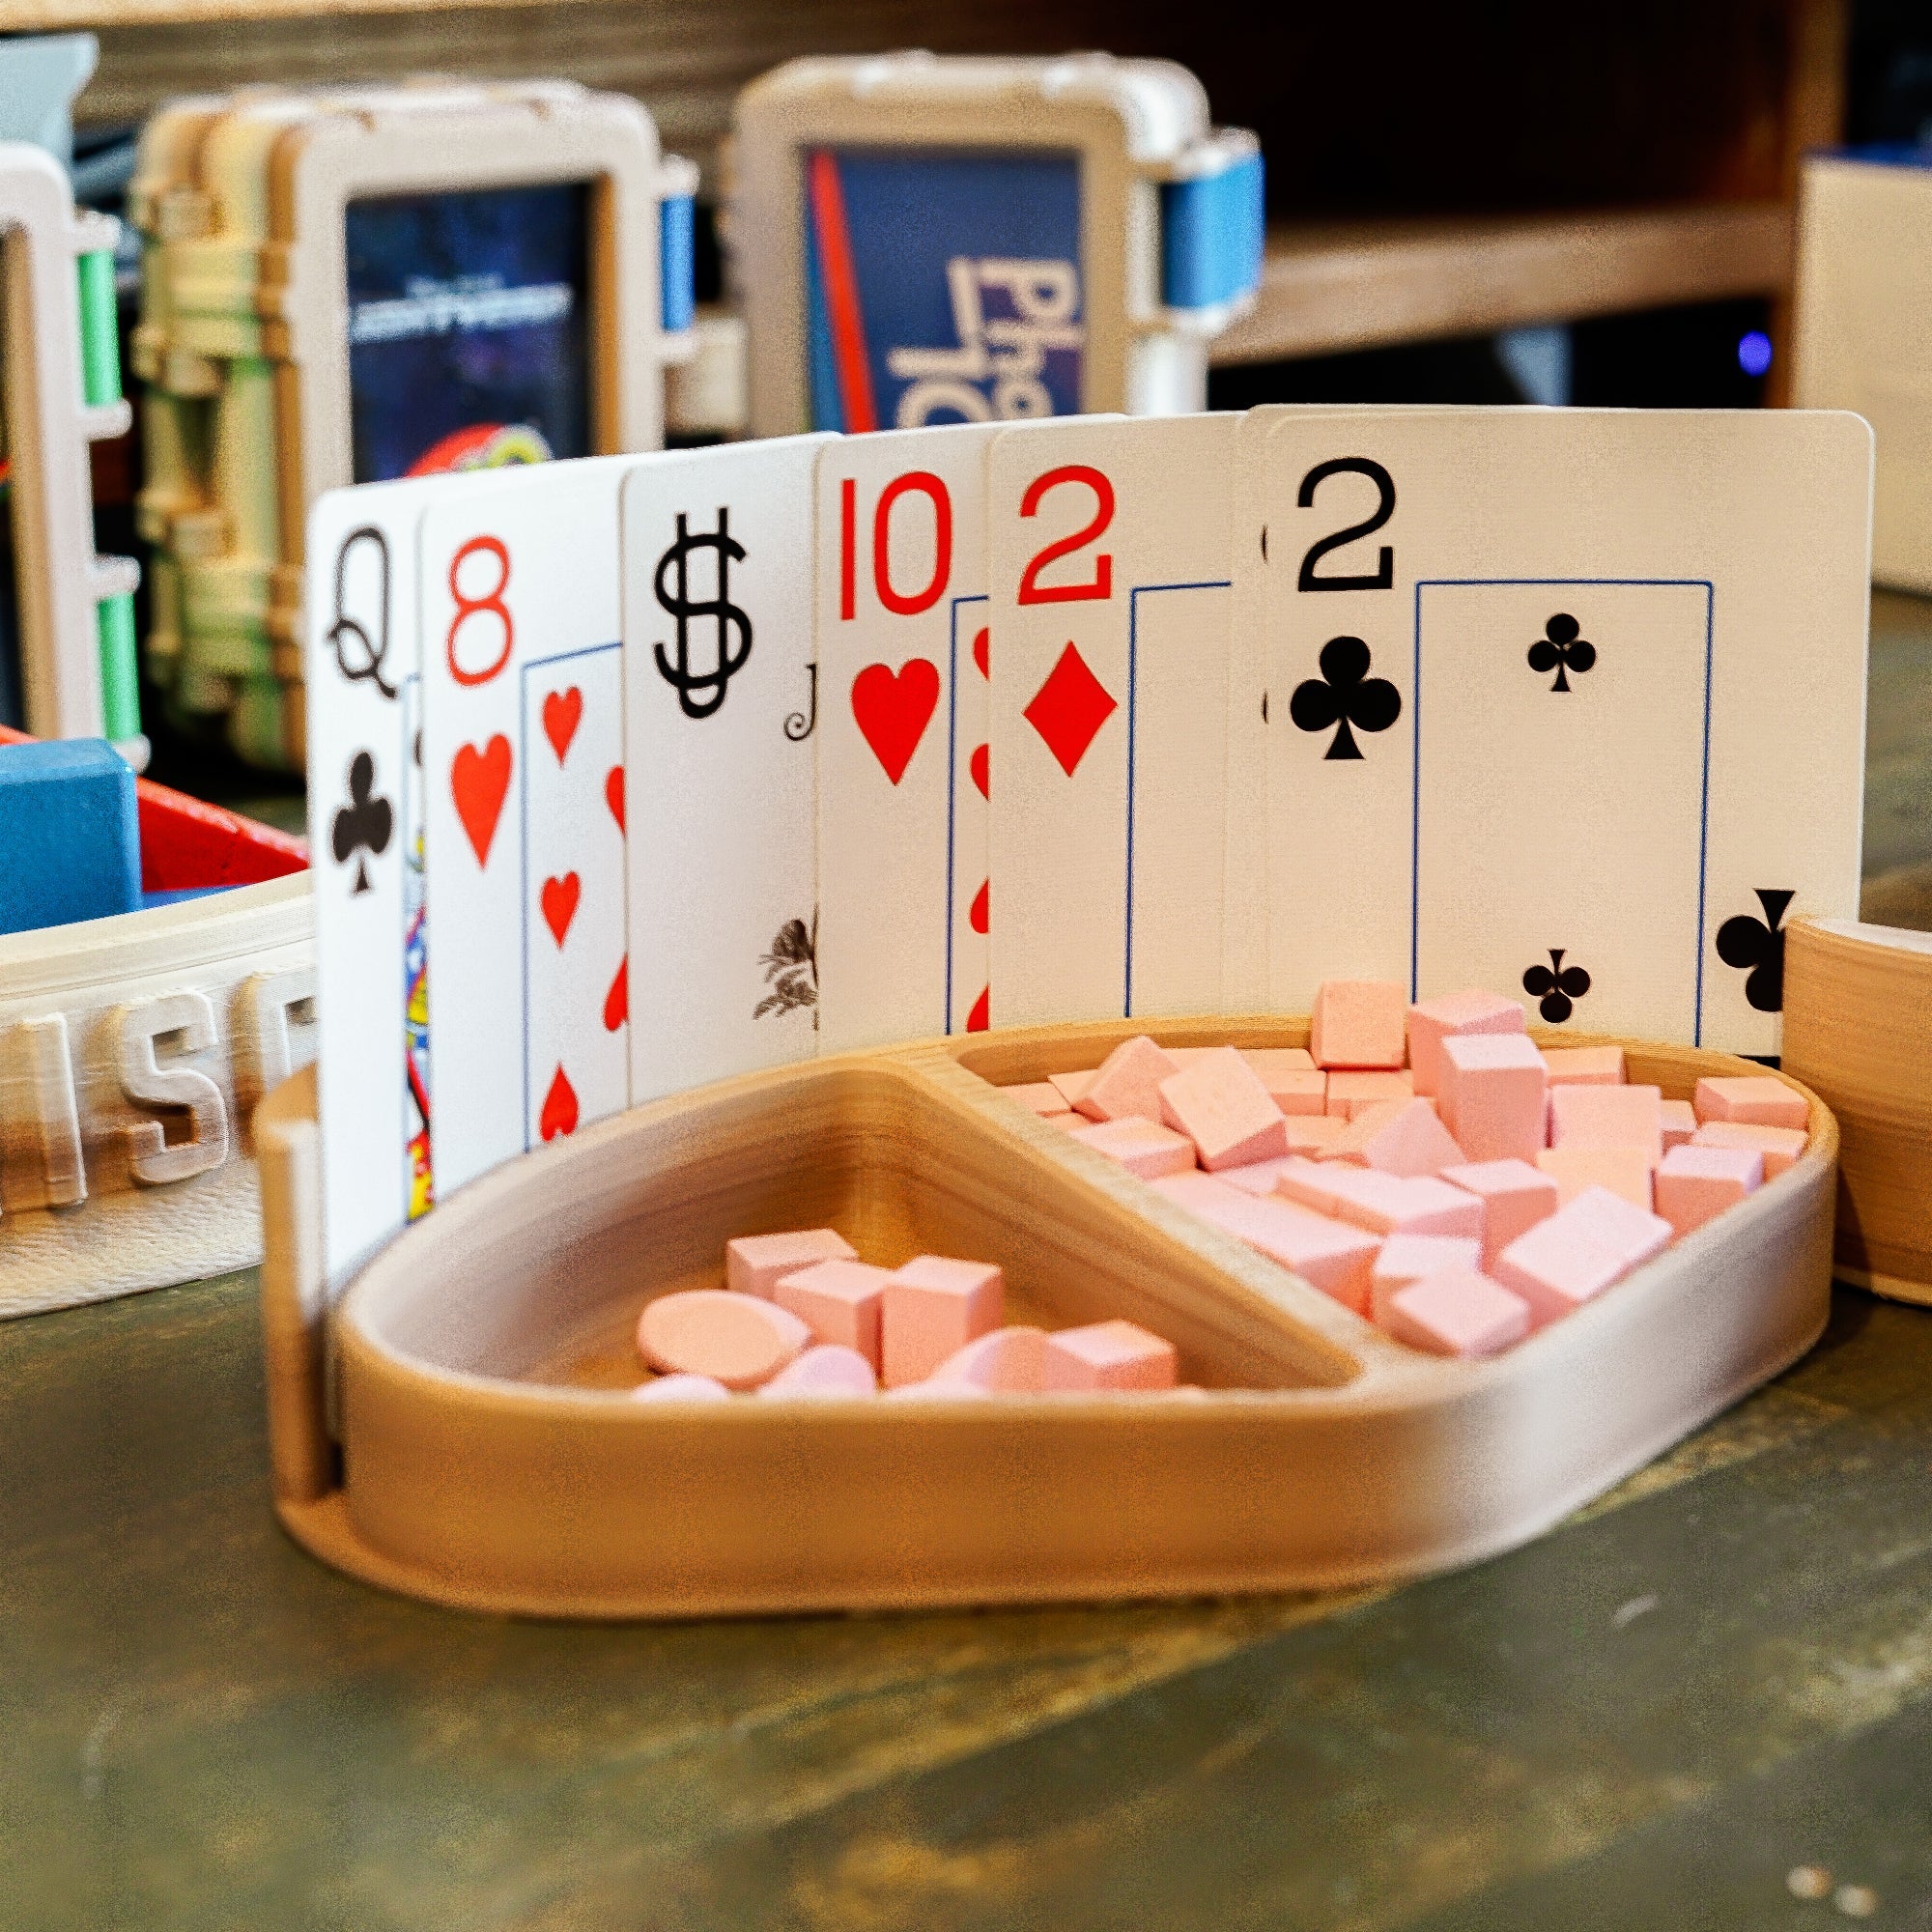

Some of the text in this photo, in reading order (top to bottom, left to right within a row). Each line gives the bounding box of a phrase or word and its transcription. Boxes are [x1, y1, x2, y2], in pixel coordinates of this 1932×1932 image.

[840, 470, 952, 619] 10
[1017, 465, 1116, 605] 2
[1296, 456, 1396, 592] 2
[326, 525, 399, 700] Q
[446, 533, 515, 689] 8
